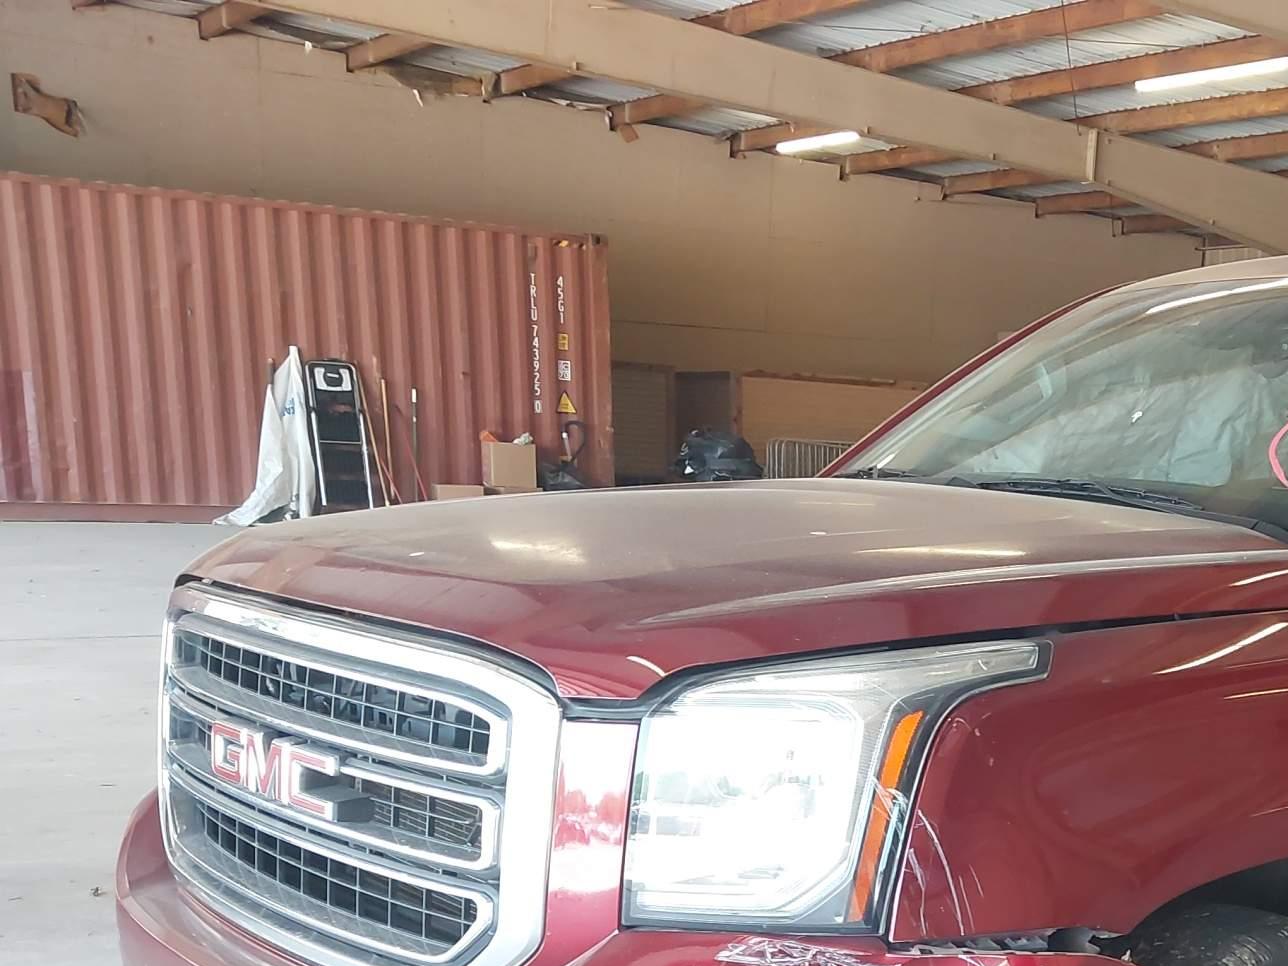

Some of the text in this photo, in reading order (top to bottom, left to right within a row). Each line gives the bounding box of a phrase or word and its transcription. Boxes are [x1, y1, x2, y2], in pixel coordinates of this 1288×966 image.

[529, 273, 538, 322] TRLU
[556, 276, 565, 324] 45G1
[531, 325, 541, 396] 743925
[212, 720, 340, 823] GMC
